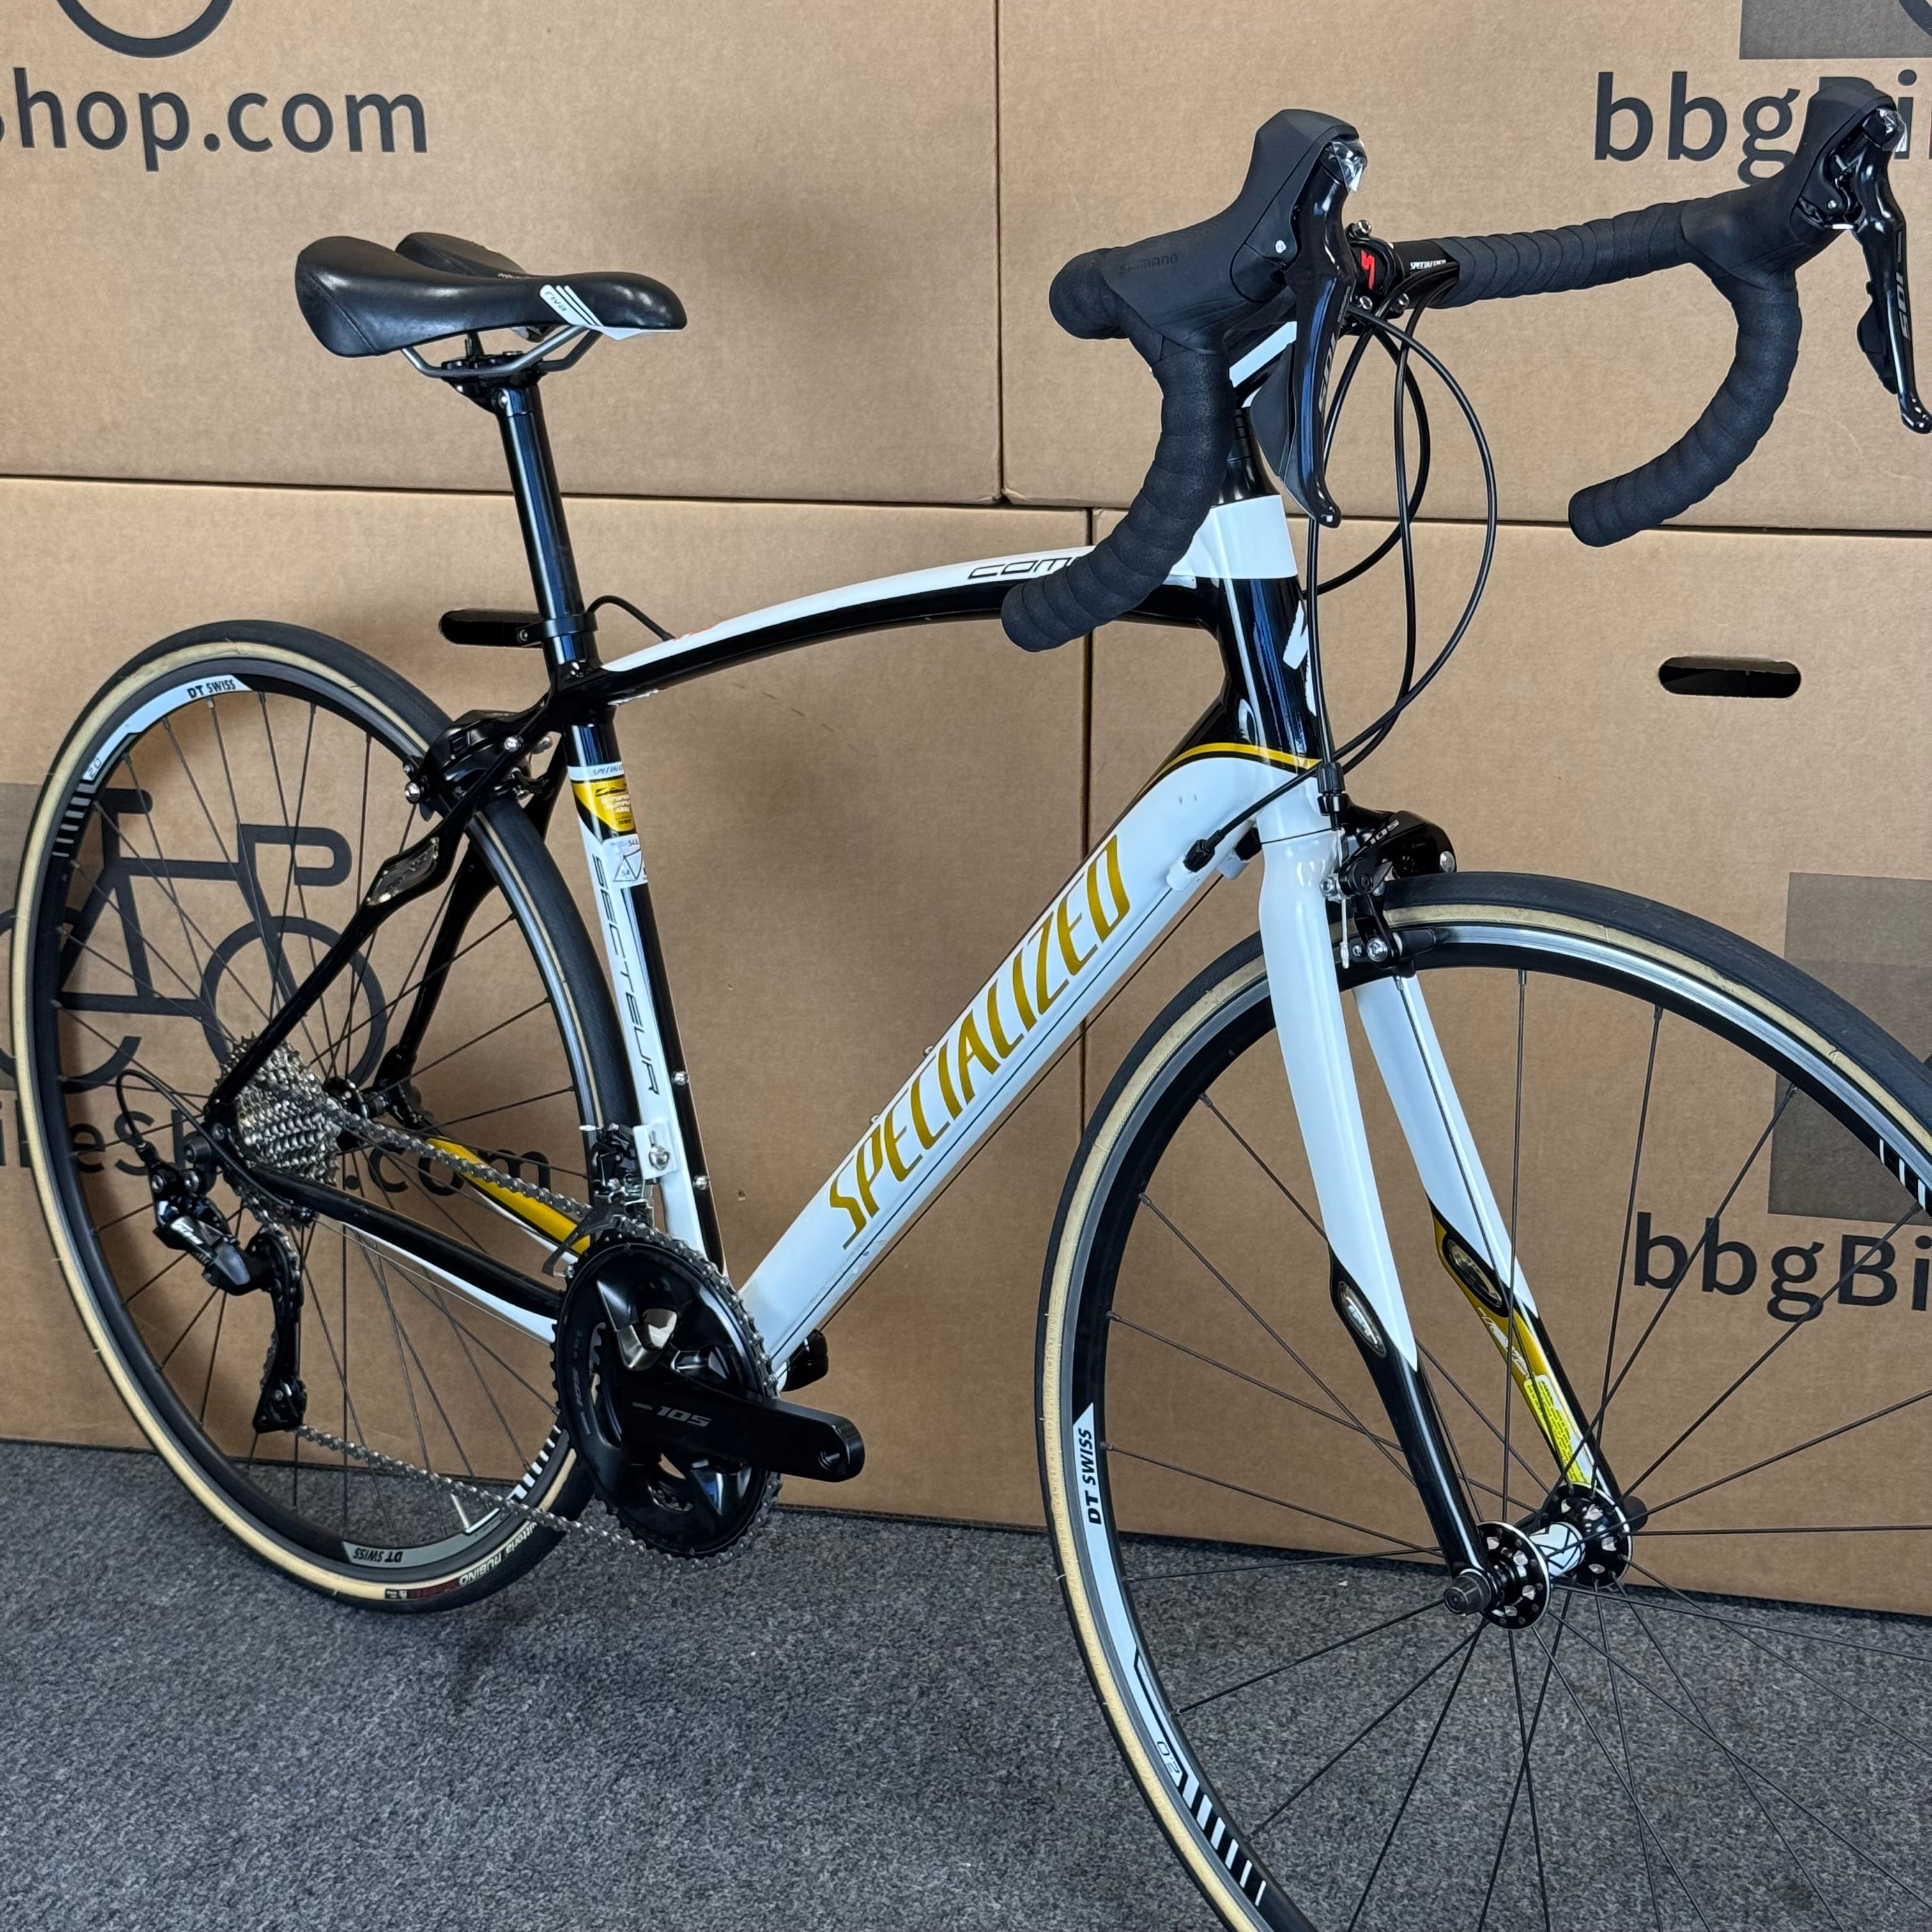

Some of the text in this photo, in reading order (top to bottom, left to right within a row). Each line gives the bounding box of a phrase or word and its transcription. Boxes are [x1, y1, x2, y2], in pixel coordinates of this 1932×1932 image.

[0, 67, 427, 172] hop.com
[1593, 70, 1932, 187] bbgi
[187, 679, 236, 698] DT SWISS
[1370, 819, 1399, 845] 105
[592, 853, 659, 1096] SECTEUR
[830, 834, 1130, 1250] SPECIALIZED
[657, 1406, 712, 1427] 105
[1078, 1428, 1101, 1525] DT SWISS
[353, 1548, 404, 1563] DT SWISS
[1157, 1741, 1181, 1774] 2.0
